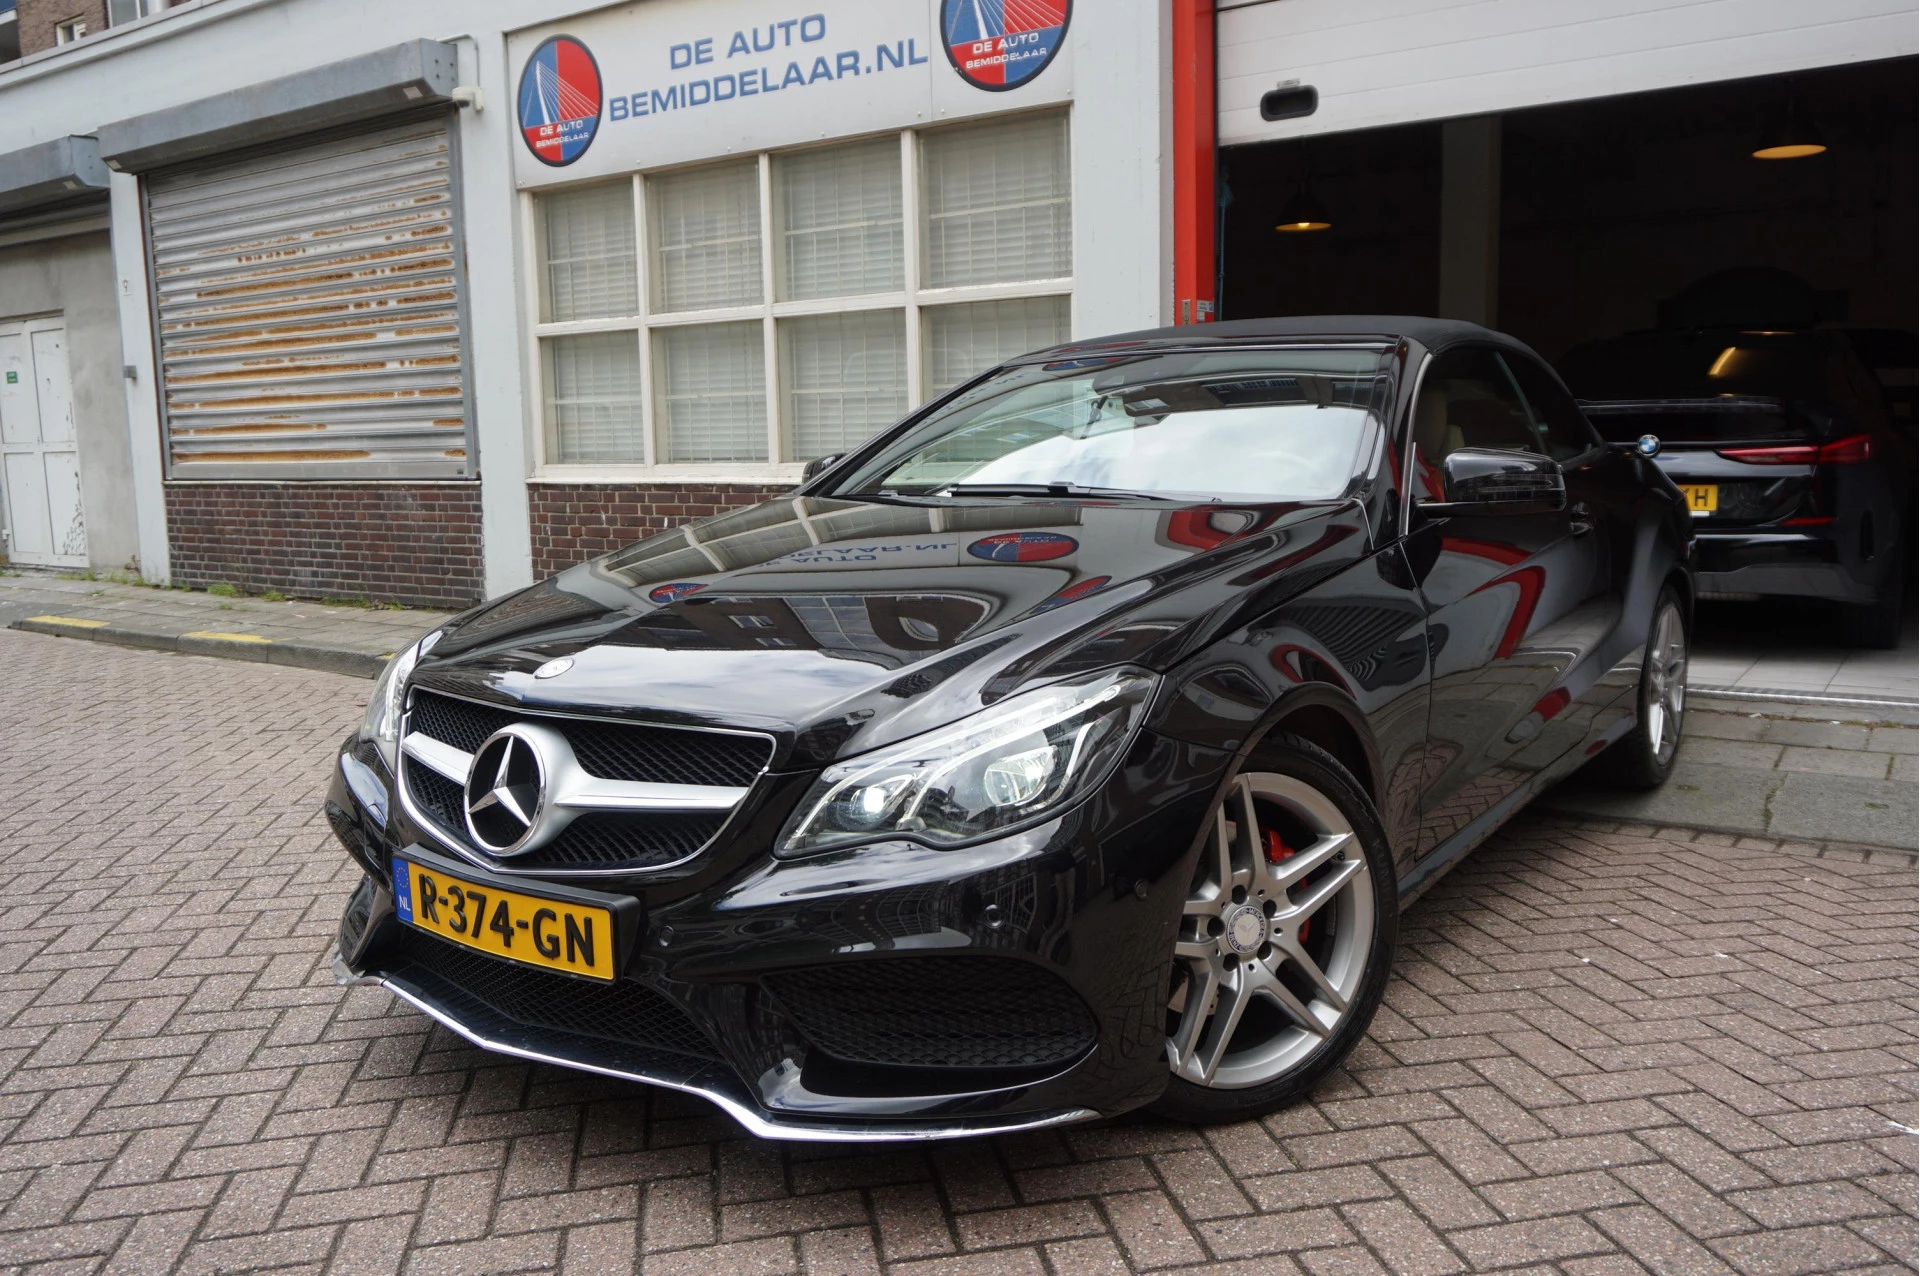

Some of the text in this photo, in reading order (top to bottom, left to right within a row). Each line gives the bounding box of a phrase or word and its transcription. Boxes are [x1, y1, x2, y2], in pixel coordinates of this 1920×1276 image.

[670, 13, 826, 70] DE AUTO
[972, 32, 1039, 54] DE AUTO
[965, 47, 1047, 69] BEMIDDELAAR
[609, 38, 928, 121] BEMIDDELAAR.NL
[540, 120, 584, 136] DE AUTO
[535, 132, 589, 148] BEMIDDELAAR
[398, 894, 411, 912] NL
[419, 873, 595, 967] R-374-GN
